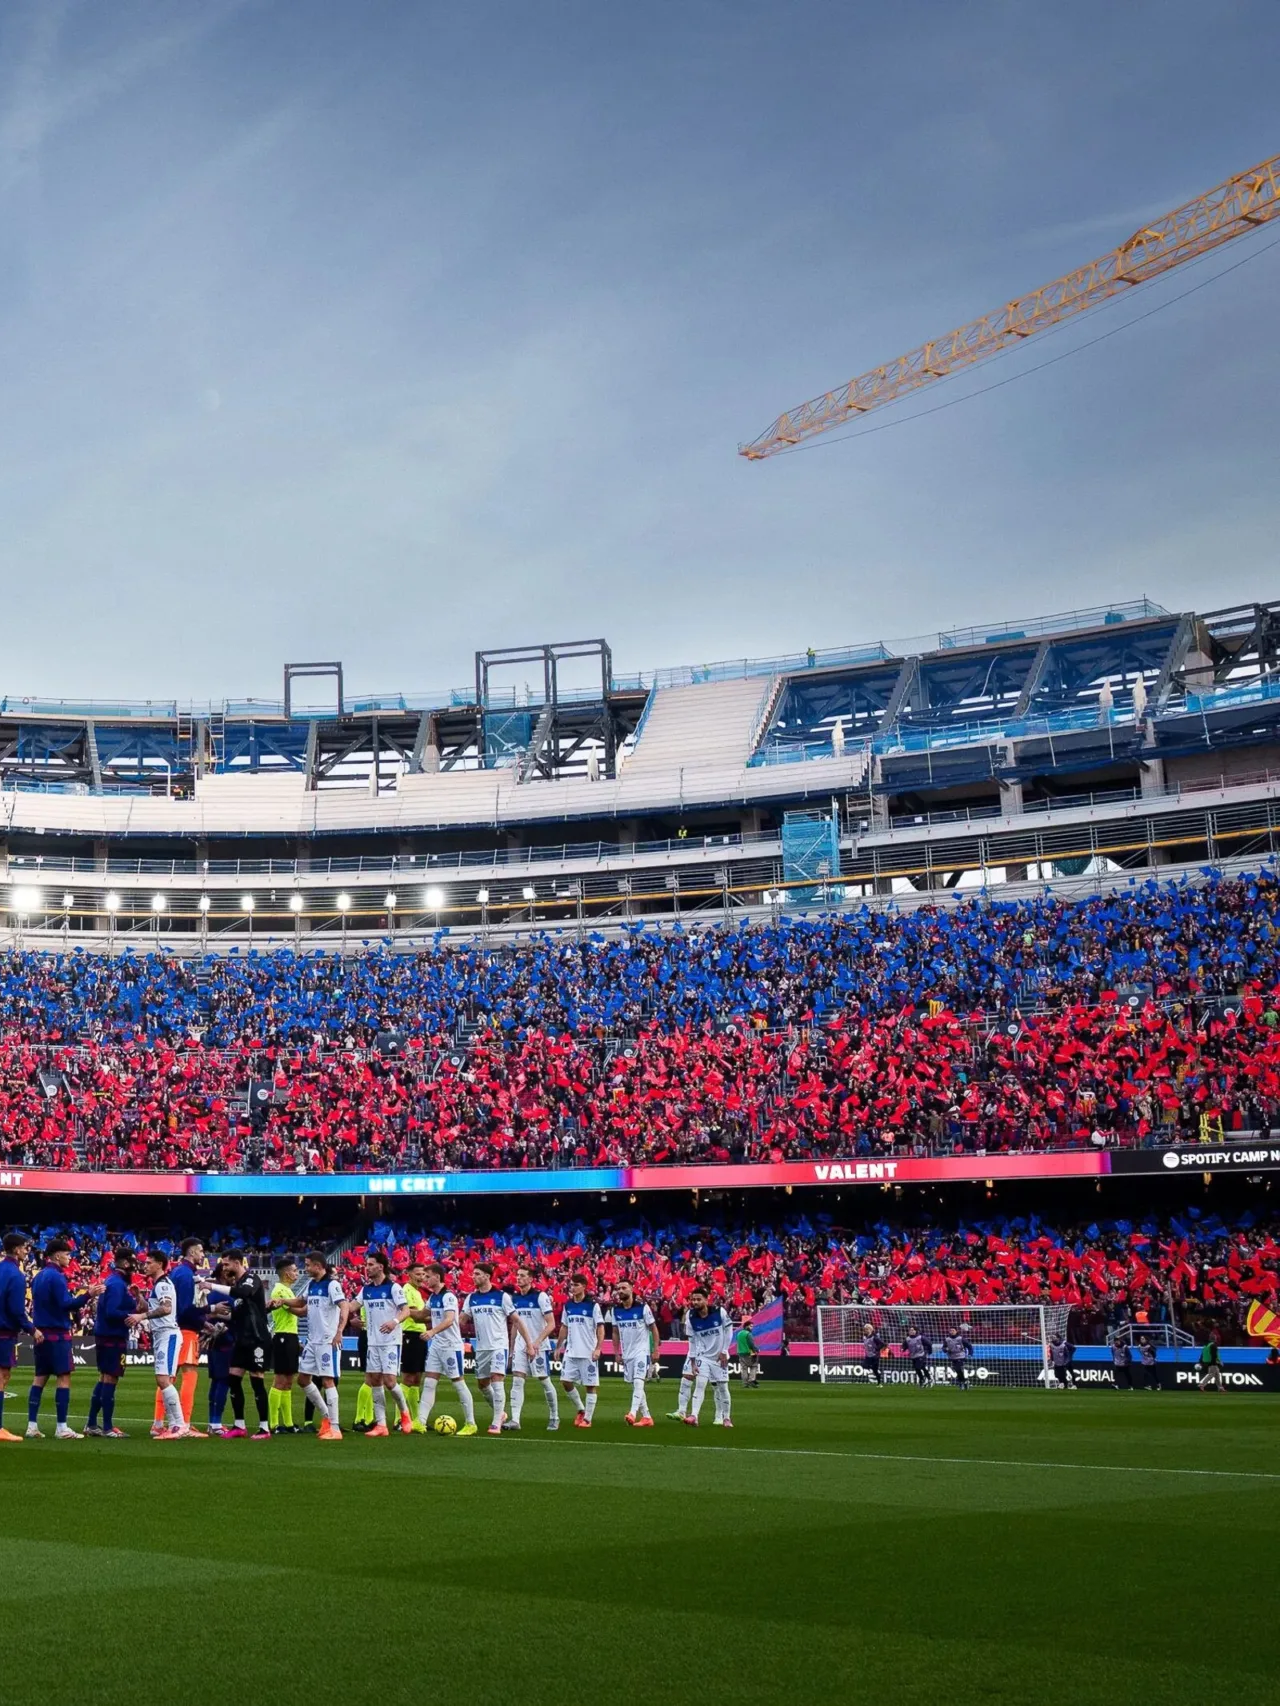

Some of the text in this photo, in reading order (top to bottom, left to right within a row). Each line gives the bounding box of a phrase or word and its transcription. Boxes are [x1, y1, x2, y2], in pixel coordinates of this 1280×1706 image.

[1180, 1150, 1280, 1165] SPOTIFY CAMP N
[814, 1162, 898, 1180] VALENT
[400, 1176, 447, 1192] CRIT
[125, 1355, 155, 1364] EMP
